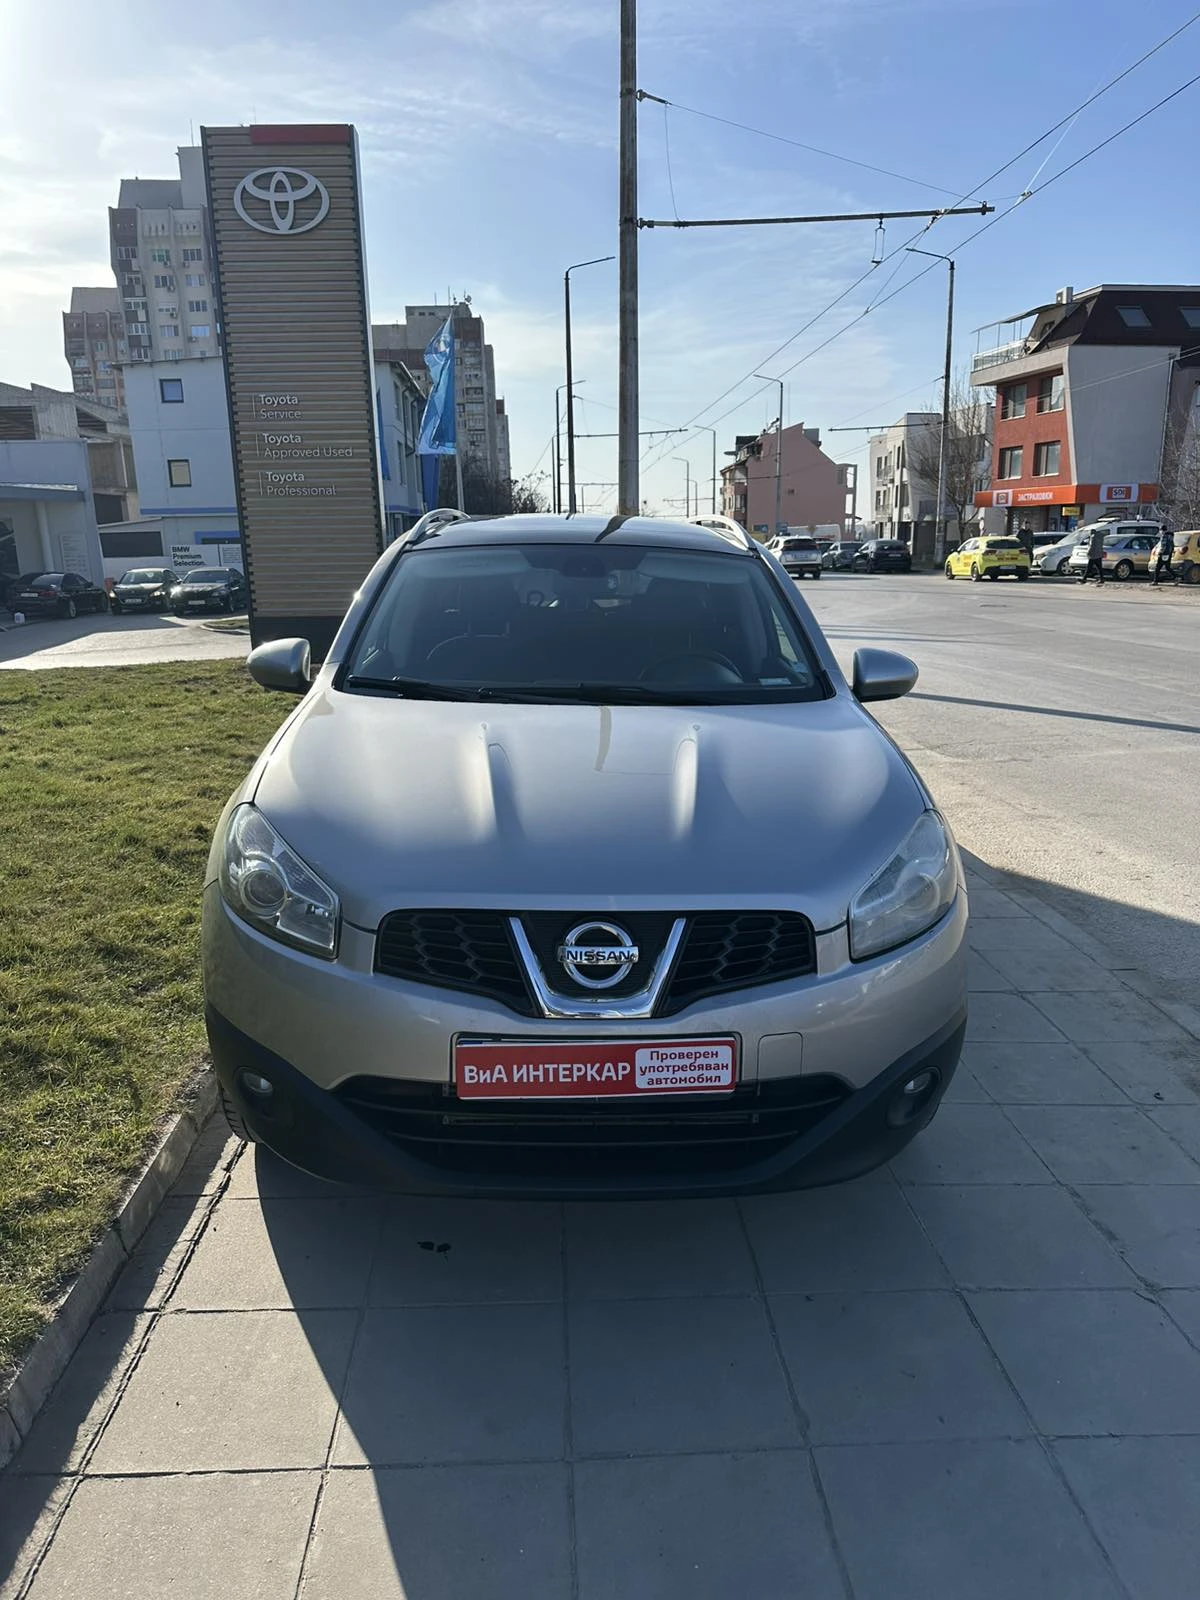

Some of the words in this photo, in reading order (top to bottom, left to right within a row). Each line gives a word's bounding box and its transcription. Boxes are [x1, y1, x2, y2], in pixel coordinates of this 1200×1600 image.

[259, 394, 299, 406] Toyota
[260, 409, 302, 419] Service
[262, 433, 302, 445] Toyota
[264, 447, 320, 460] Approved
[324, 447, 353, 457] Used
[266, 471, 305, 484] Toyota
[267, 485, 337, 496] Professional
[566, 949, 631, 962] NISSAN
[650, 1048, 719, 1063] Проверен
[463, 1065, 508, 1085] ВиА
[512, 1062, 632, 1083] ИНТЕРКАР
[639, 1060, 729, 1076] употребяван
[647, 1073, 722, 1086] автомобил
